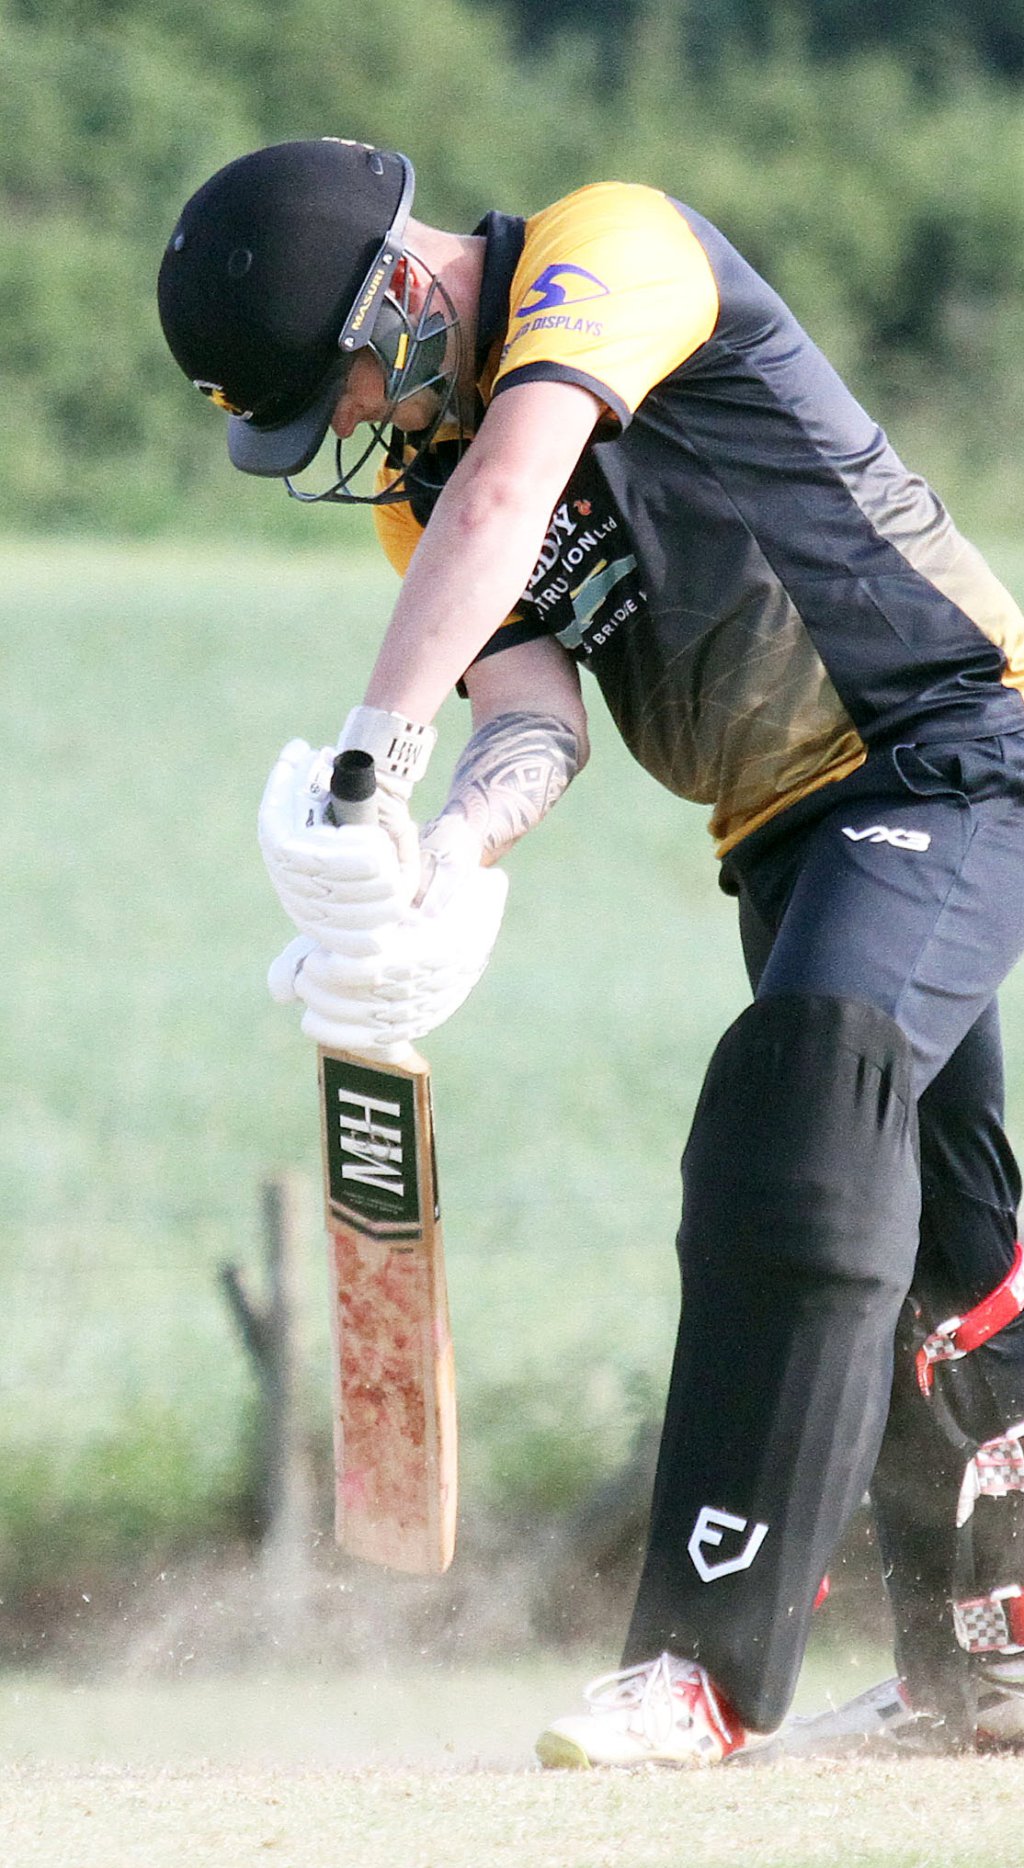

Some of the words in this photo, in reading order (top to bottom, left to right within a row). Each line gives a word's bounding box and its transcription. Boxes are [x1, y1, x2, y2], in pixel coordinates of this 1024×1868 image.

[351, 269, 385, 331] MASURI
[531, 315, 604, 337] DISPLAYS
[594, 516, 617, 540] Ltd
[592, 598, 638, 646] BRIDE
